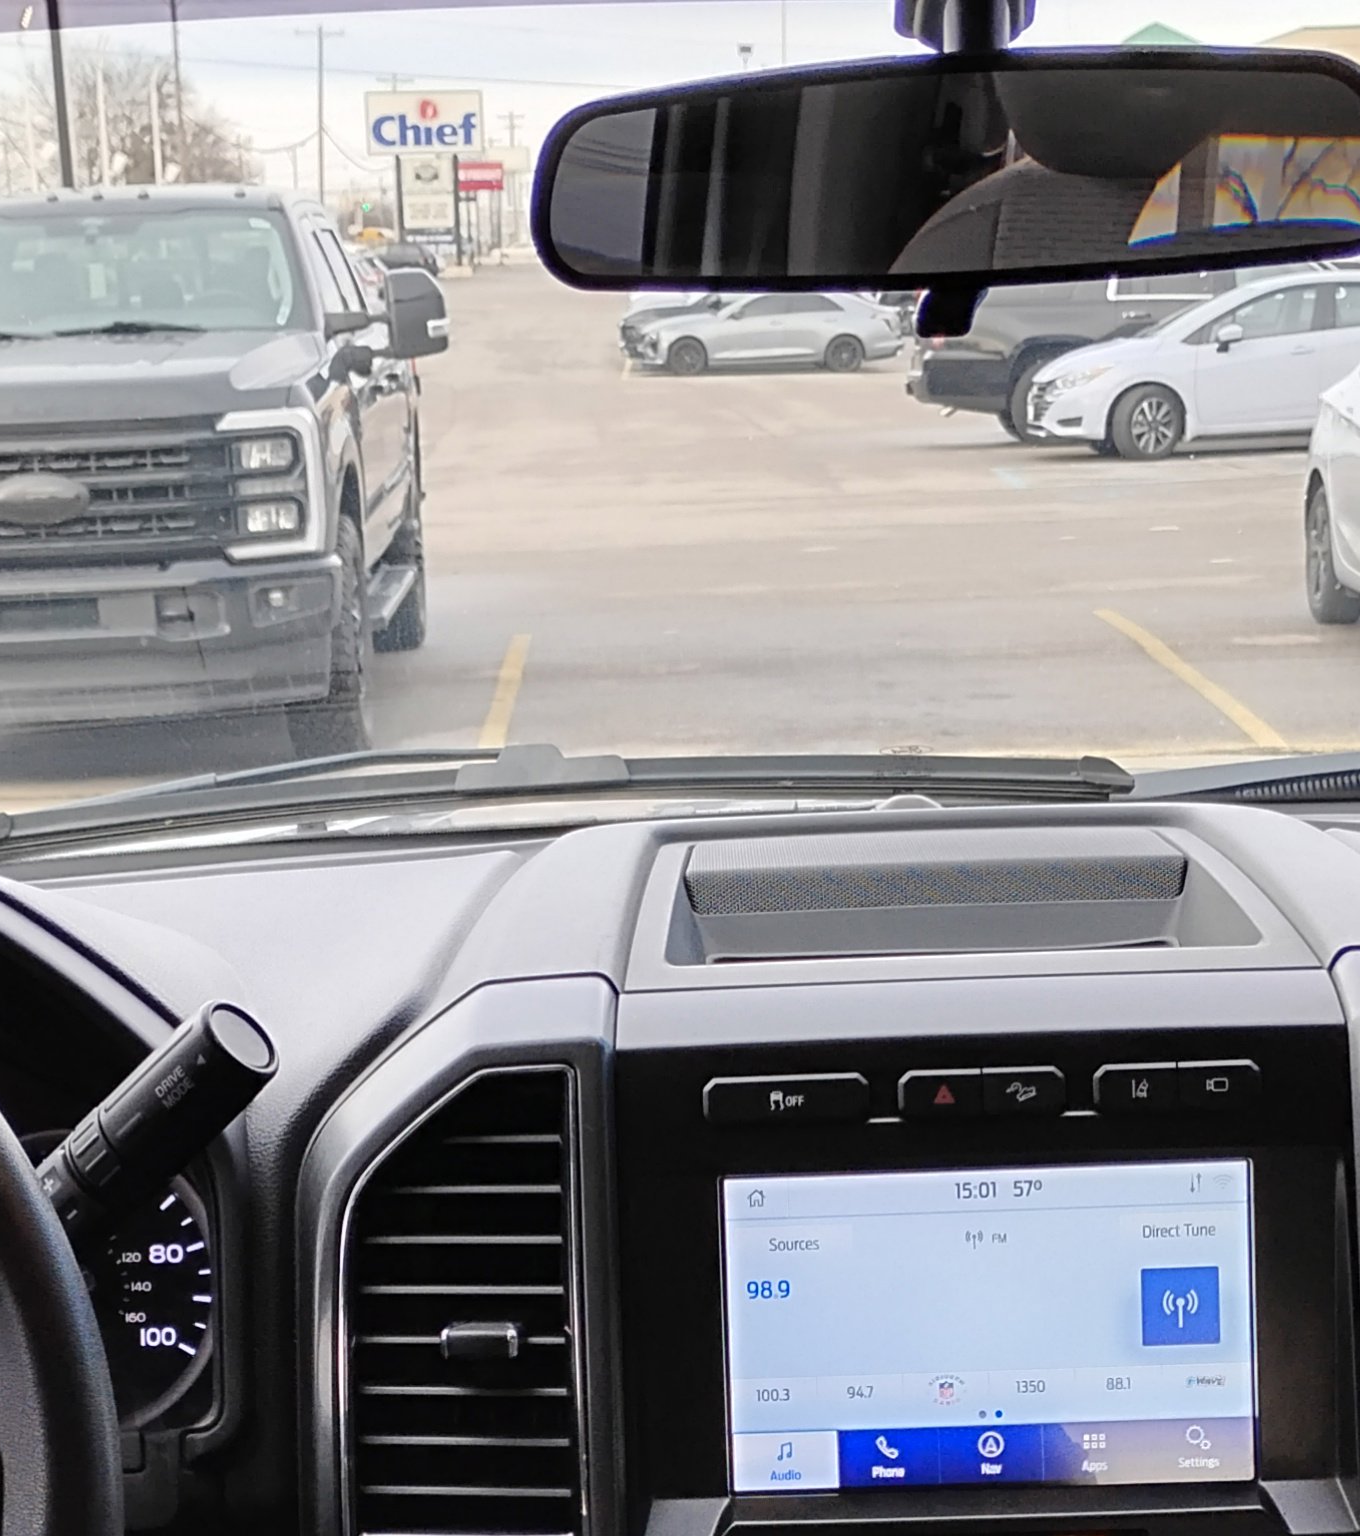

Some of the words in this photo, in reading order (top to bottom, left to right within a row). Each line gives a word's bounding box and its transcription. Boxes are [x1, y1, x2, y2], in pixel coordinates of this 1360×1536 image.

[372, 112, 476, 146] Chief
[154, 1064, 186, 1099] DRIVE
[161, 1076, 195, 1109] MODE
[785, 1095, 805, 1107] OFF
[954, 1180, 997, 1199] 15:01
[991, 1232, 1008, 1244] FM
[1141, 1223, 1181, 1239] Direct
[1183, 1222, 1216, 1237] Tune
[768, 1237, 820, 1252] Sources
[121, 1252, 142, 1263] 120
[148, 1243, 184, 1264] 80
[130, 1281, 152, 1292] 140
[746, 1279, 791, 1300] 98.9
[125, 1312, 147, 1323] 160
[139, 1326, 177, 1347] 100
[1015, 1379, 1046, 1394] 1350
[1105, 1376, 1132, 1391] 88.1
[755, 1388, 791, 1403] 100.3
[846, 1386, 874, 1400] 94.7
[980, 1462, 1003, 1475] Nav
[1081, 1460, 1108, 1473] Apps
[1177, 1456, 1220, 1469] Settings
[770, 1470, 802, 1482] Audio
[871, 1465, 906, 1480] Phone
